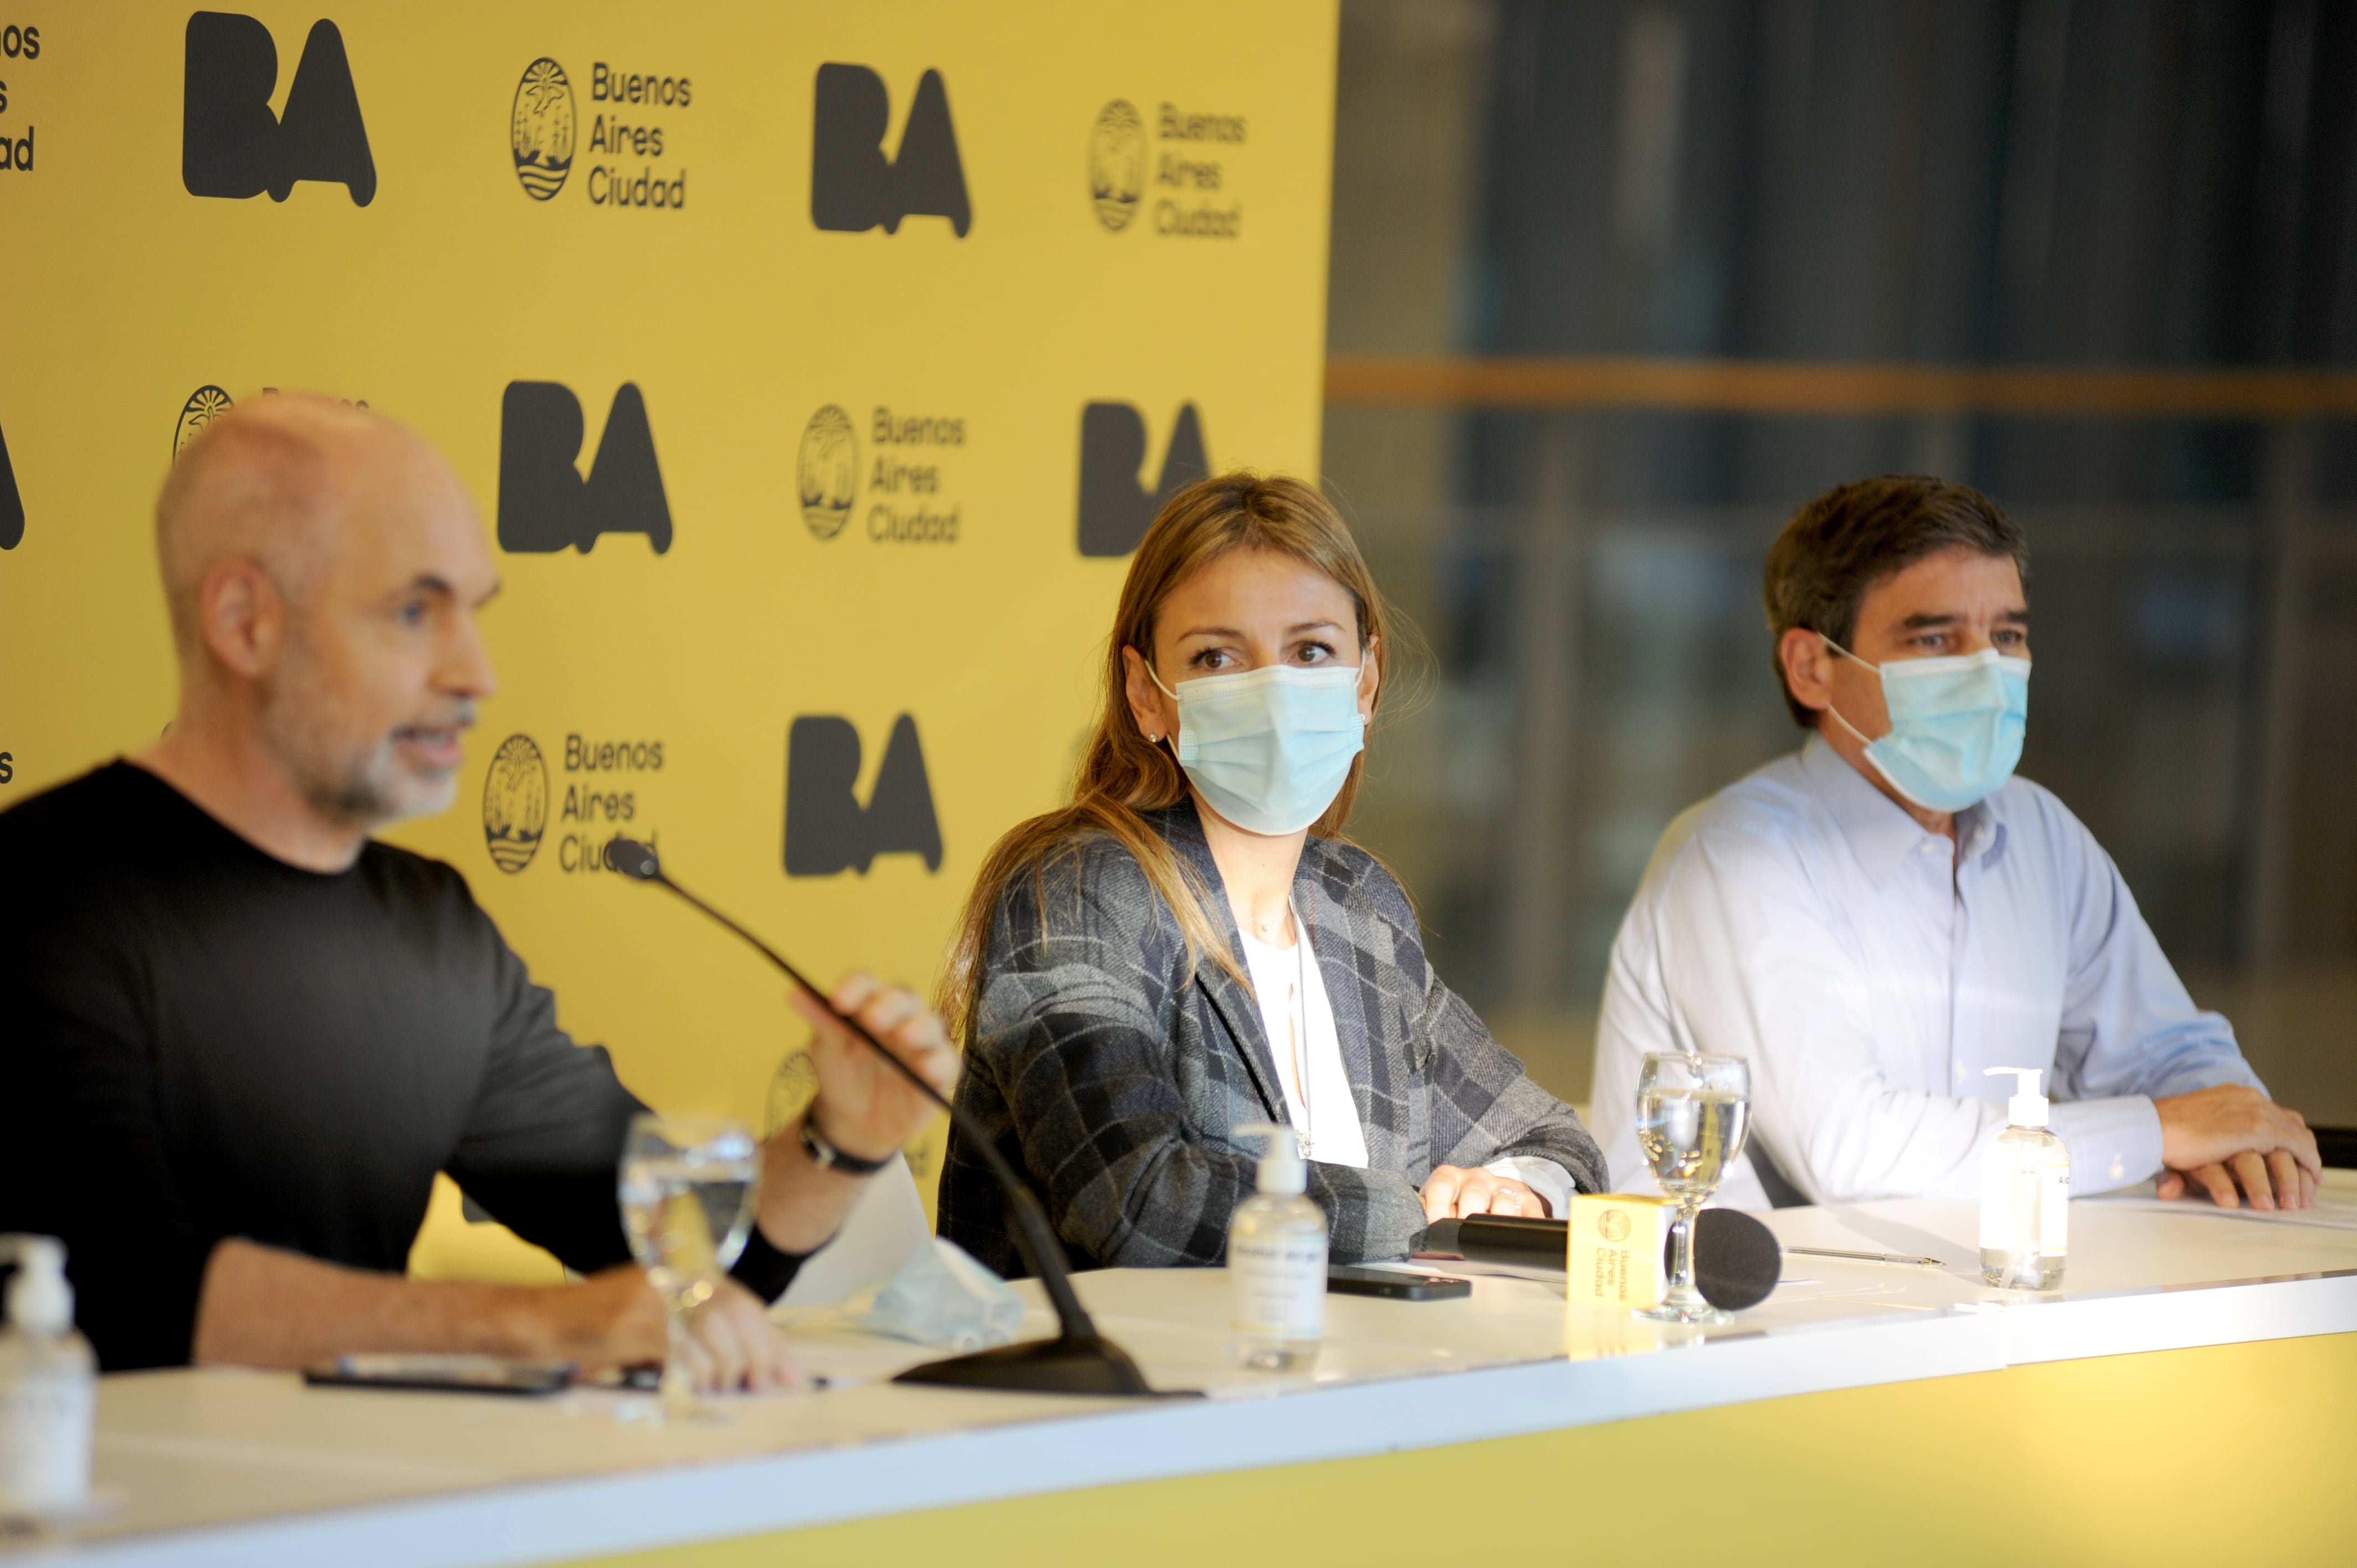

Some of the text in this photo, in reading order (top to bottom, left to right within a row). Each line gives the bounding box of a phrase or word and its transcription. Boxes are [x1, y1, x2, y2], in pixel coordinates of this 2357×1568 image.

[592, 62, 691, 107] Buenos
[182, 11, 377, 207] BA
[1158, 102, 1246, 143] Buenos
[589, 114, 662, 157] Aires
[810, 61, 972, 239] BA
[588, 165, 685, 209] Ciudad
[1155, 153, 1221, 190] Aires
[1155, 198, 1240, 239] Ciudad
[872, 406, 964, 446] Buenos
[496, 380, 673, 556] BA
[869, 457, 939, 494] Aires
[867, 504, 959, 544] Ciudad
[564, 733, 663, 772] Buenos
[560, 784, 635, 822] Aires
[781, 712, 944, 879] BA
[559, 829, 657, 873] Ciud
[1595, 1247, 1606, 1297] Ciudad
[1607, 1249, 1618, 1286] Aires
[1618, 1250, 1630, 1301] Buenos
